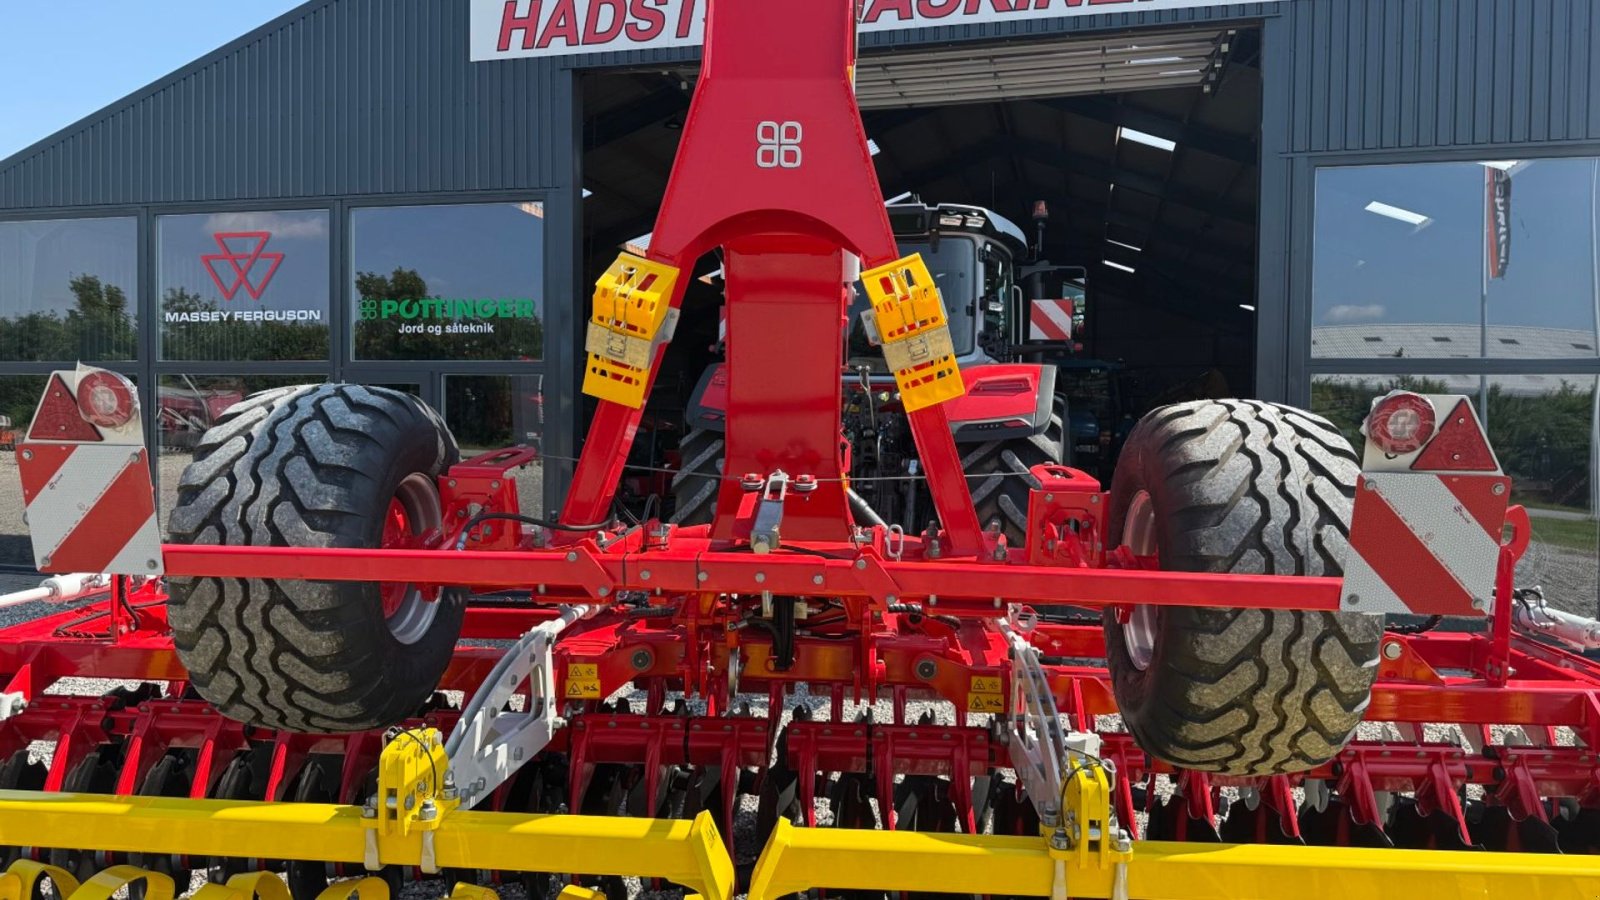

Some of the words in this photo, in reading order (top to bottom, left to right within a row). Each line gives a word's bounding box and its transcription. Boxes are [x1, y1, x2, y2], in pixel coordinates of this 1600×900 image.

[497, 0, 705, 52] HADST
[165, 311, 231, 323] MASSEY
[234, 309, 321, 322] FERGUSON
[398, 322, 424, 335] Jord
[427, 325, 442, 336] og
[445, 322, 495, 334] såteknik
